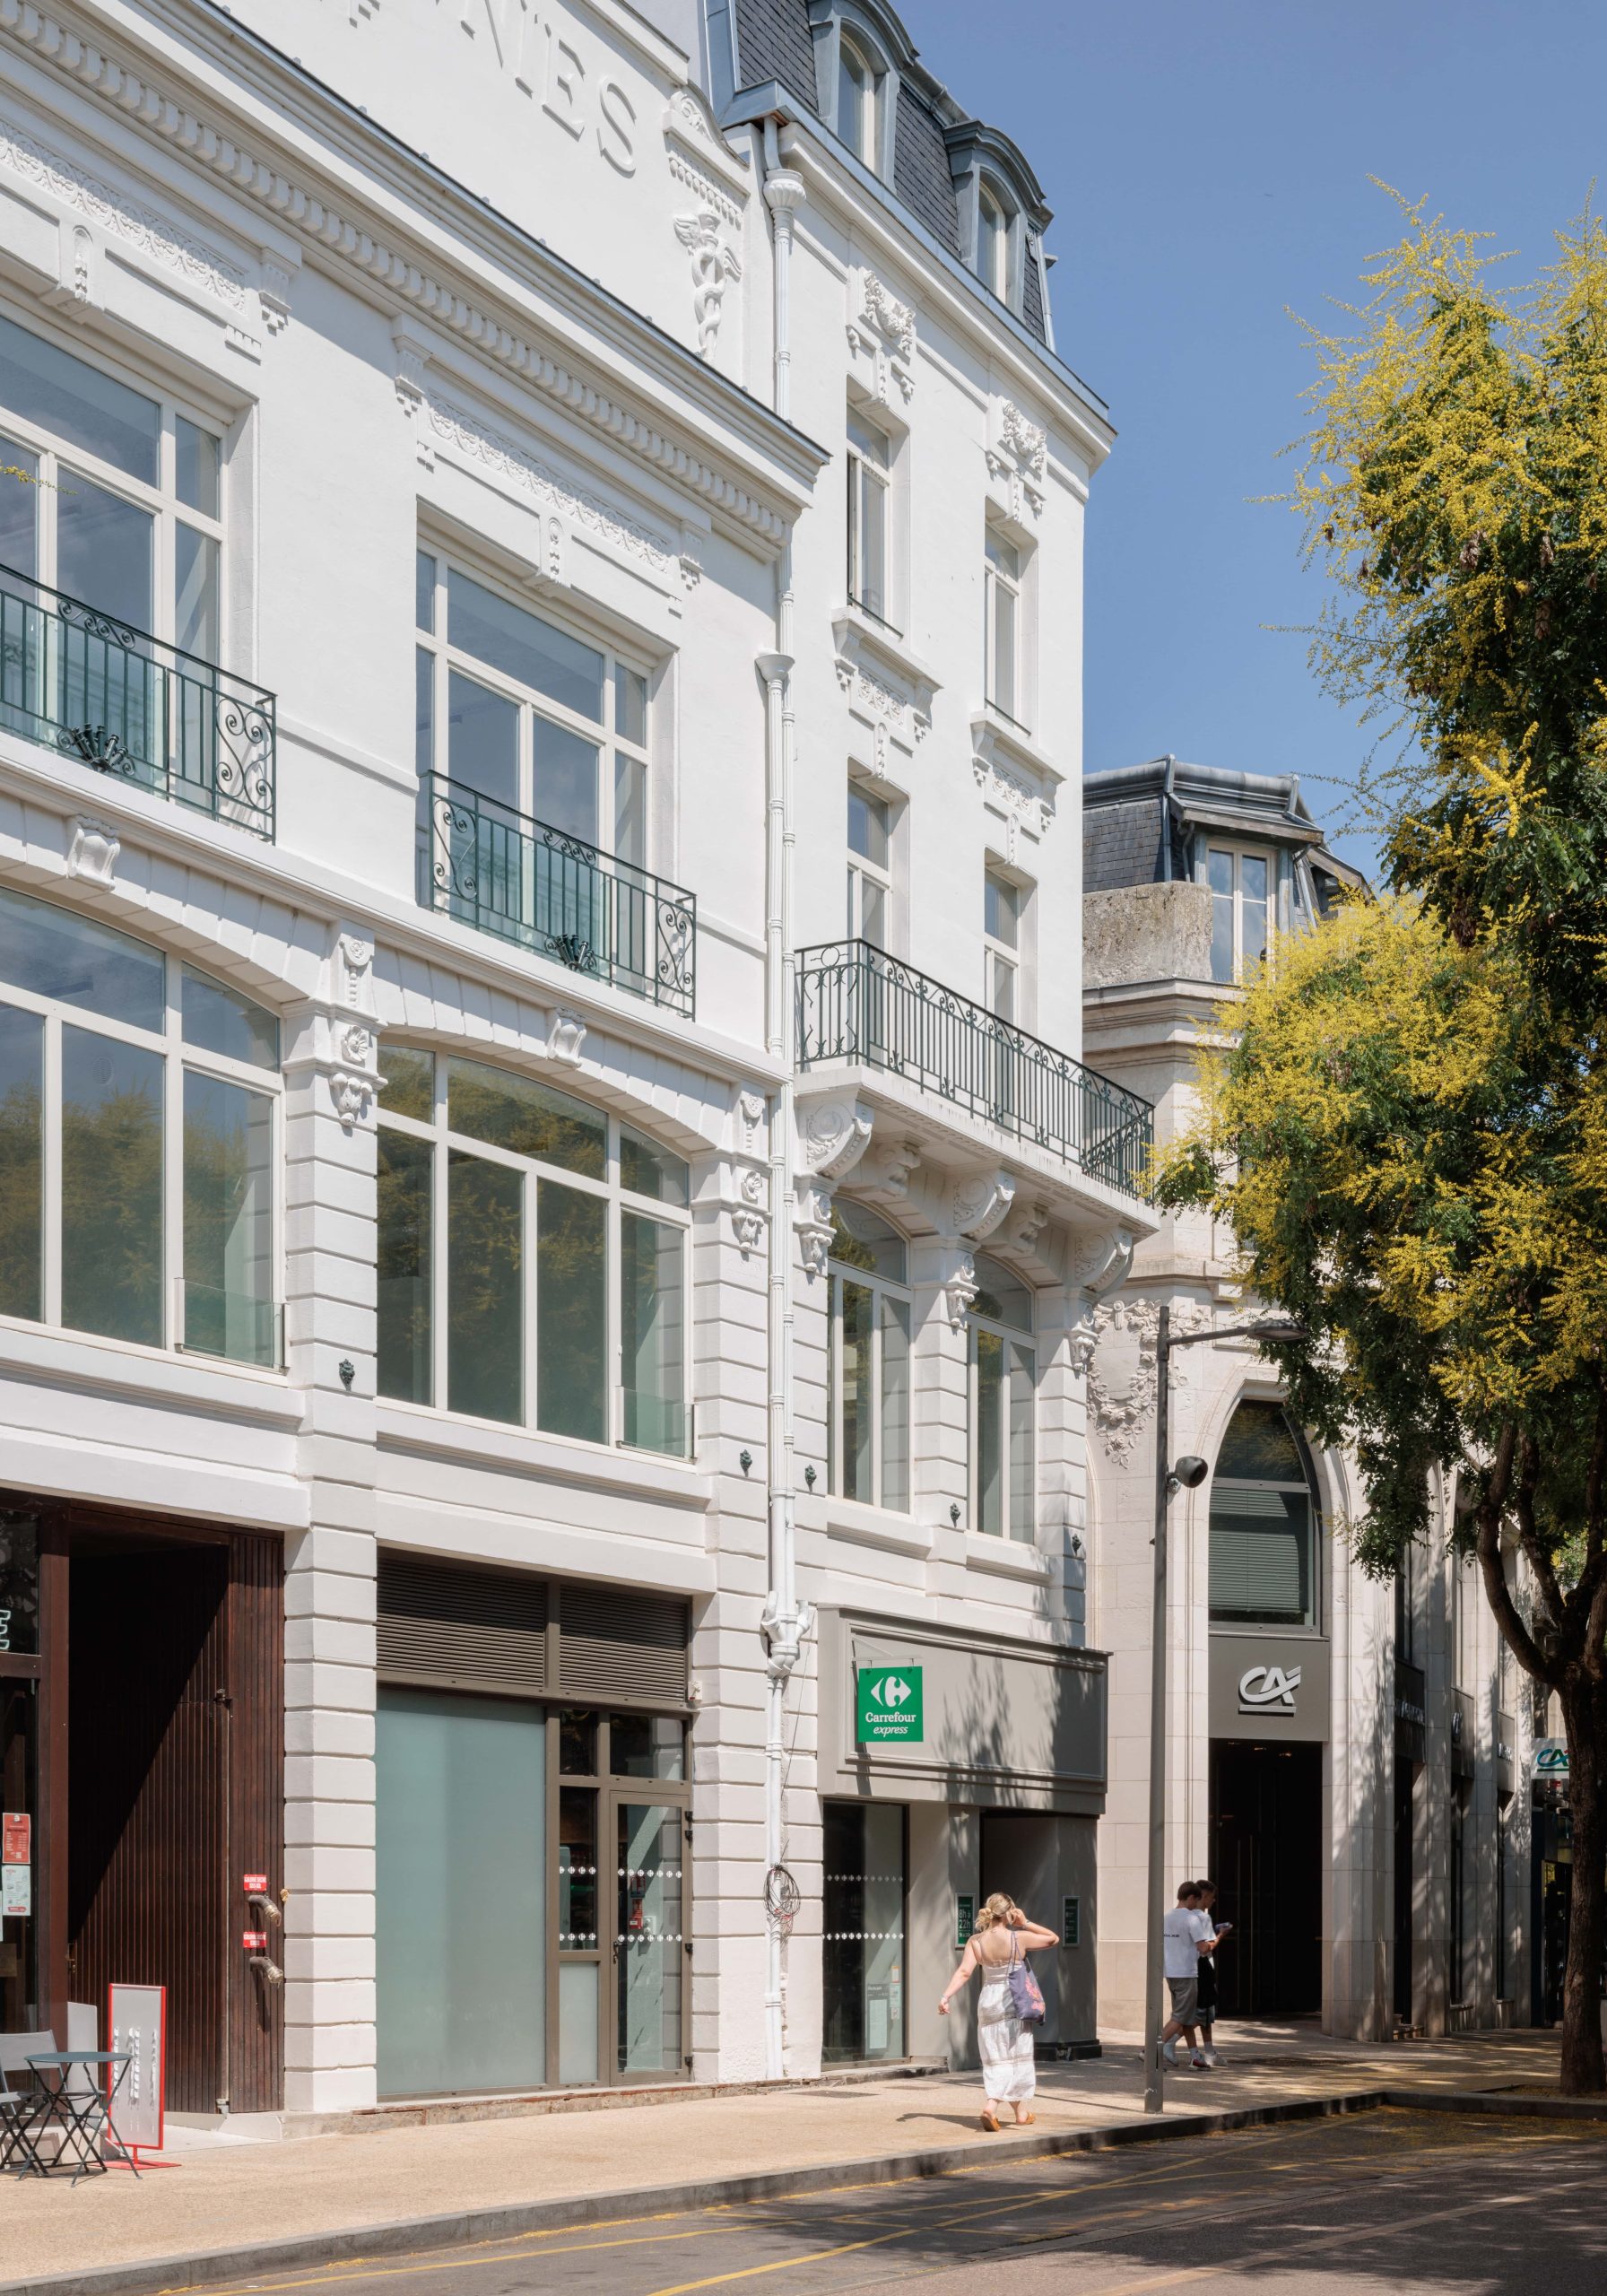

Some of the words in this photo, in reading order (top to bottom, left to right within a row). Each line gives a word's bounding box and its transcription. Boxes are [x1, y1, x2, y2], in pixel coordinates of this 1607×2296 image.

[434, 0, 637, 178] NES
[865, 1711, 916, 1723] Carrefour
[873, 1726, 908, 1738] express
